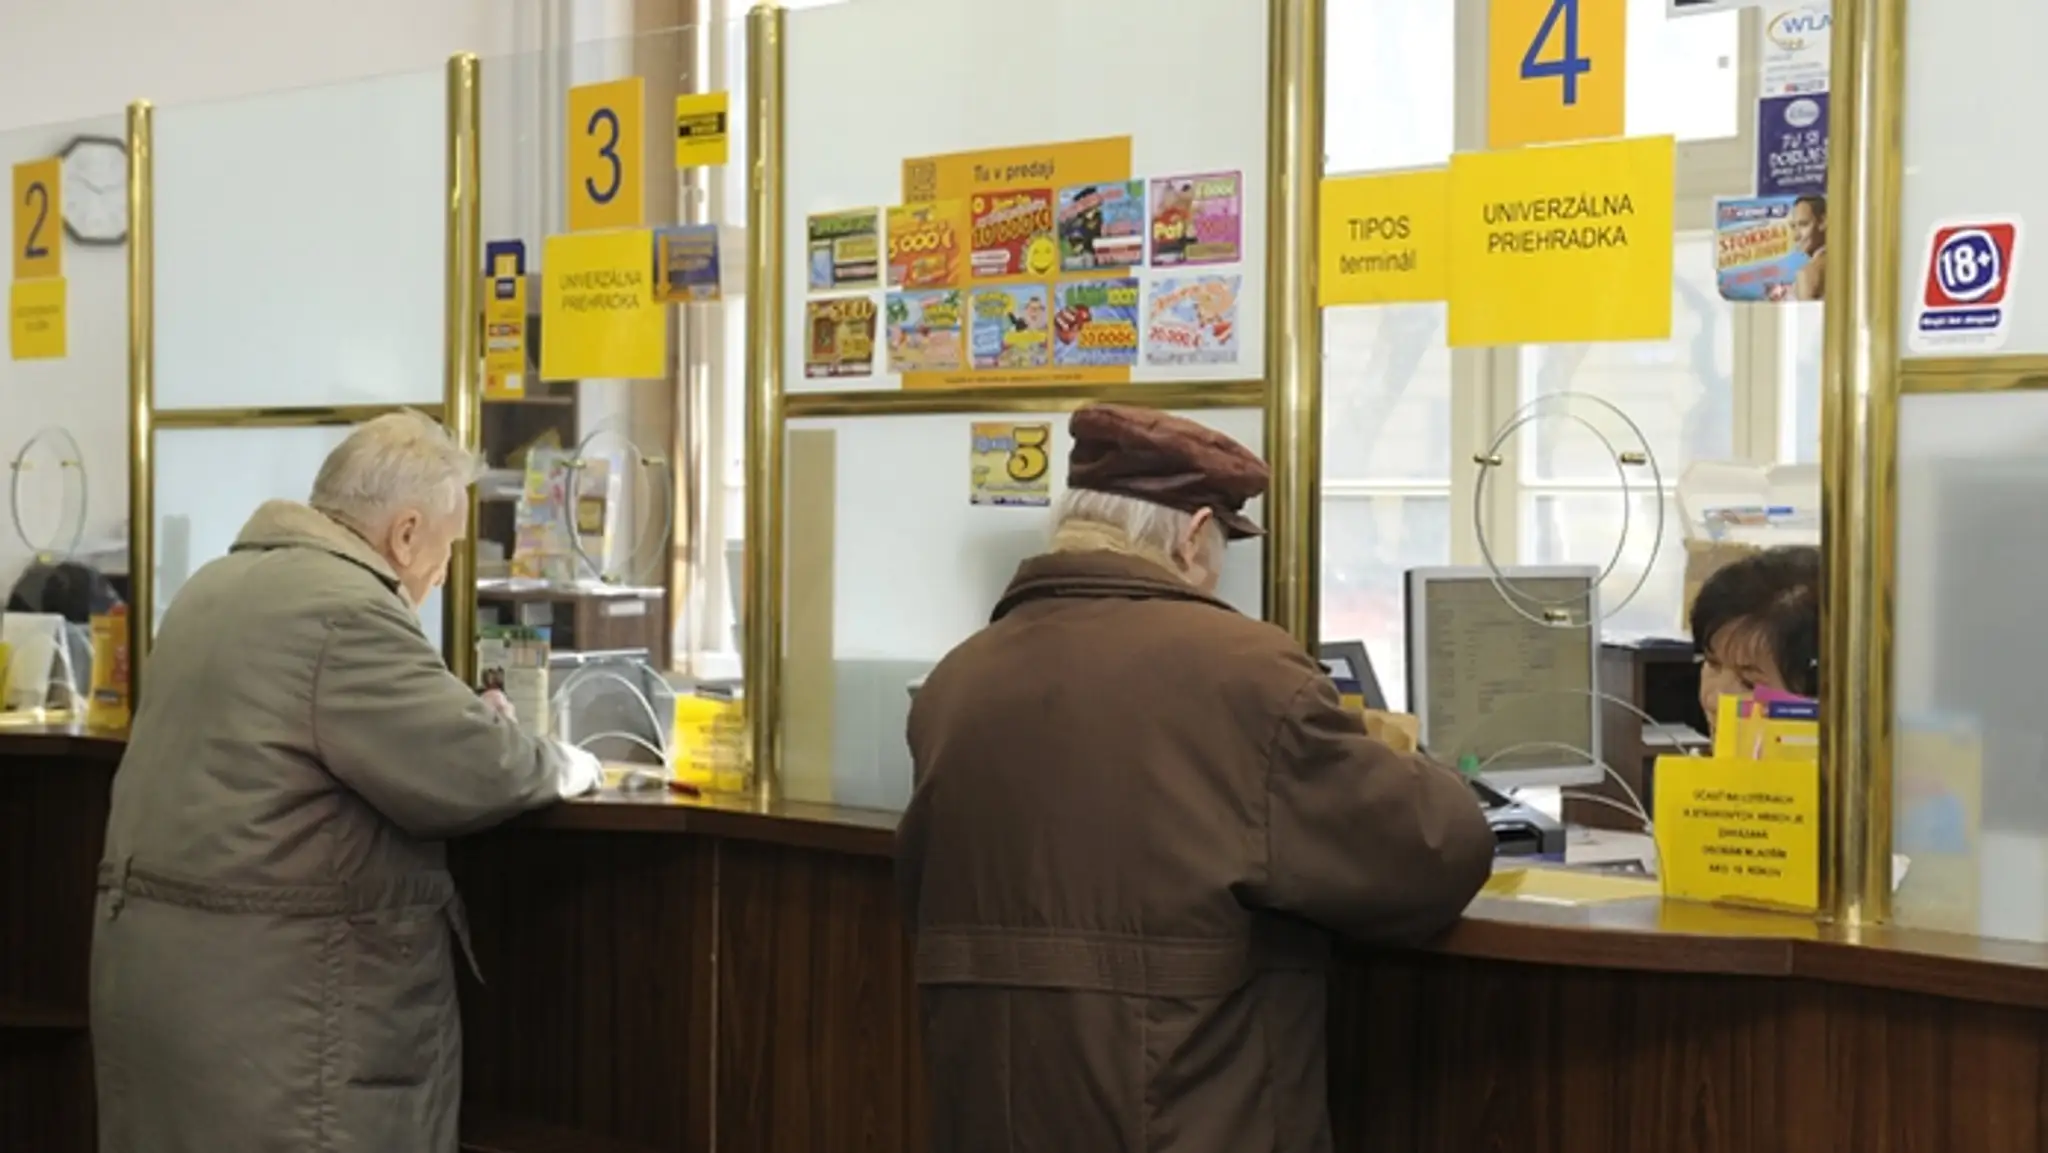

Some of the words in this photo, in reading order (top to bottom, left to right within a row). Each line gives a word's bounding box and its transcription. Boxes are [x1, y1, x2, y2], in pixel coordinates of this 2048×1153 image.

[1519, 0, 1592, 106] 4
[585, 107, 623, 205] 3
[24, 181, 49, 259] 2
[1483, 191, 1634, 225] UNIVERZÁLNA
[1348, 215, 1411, 242] TIPOS
[1487, 225, 1628, 254] PRIEHRADKA
[1339, 249, 1416, 275] terminál
[1942, 243, 1991, 287] 18+
